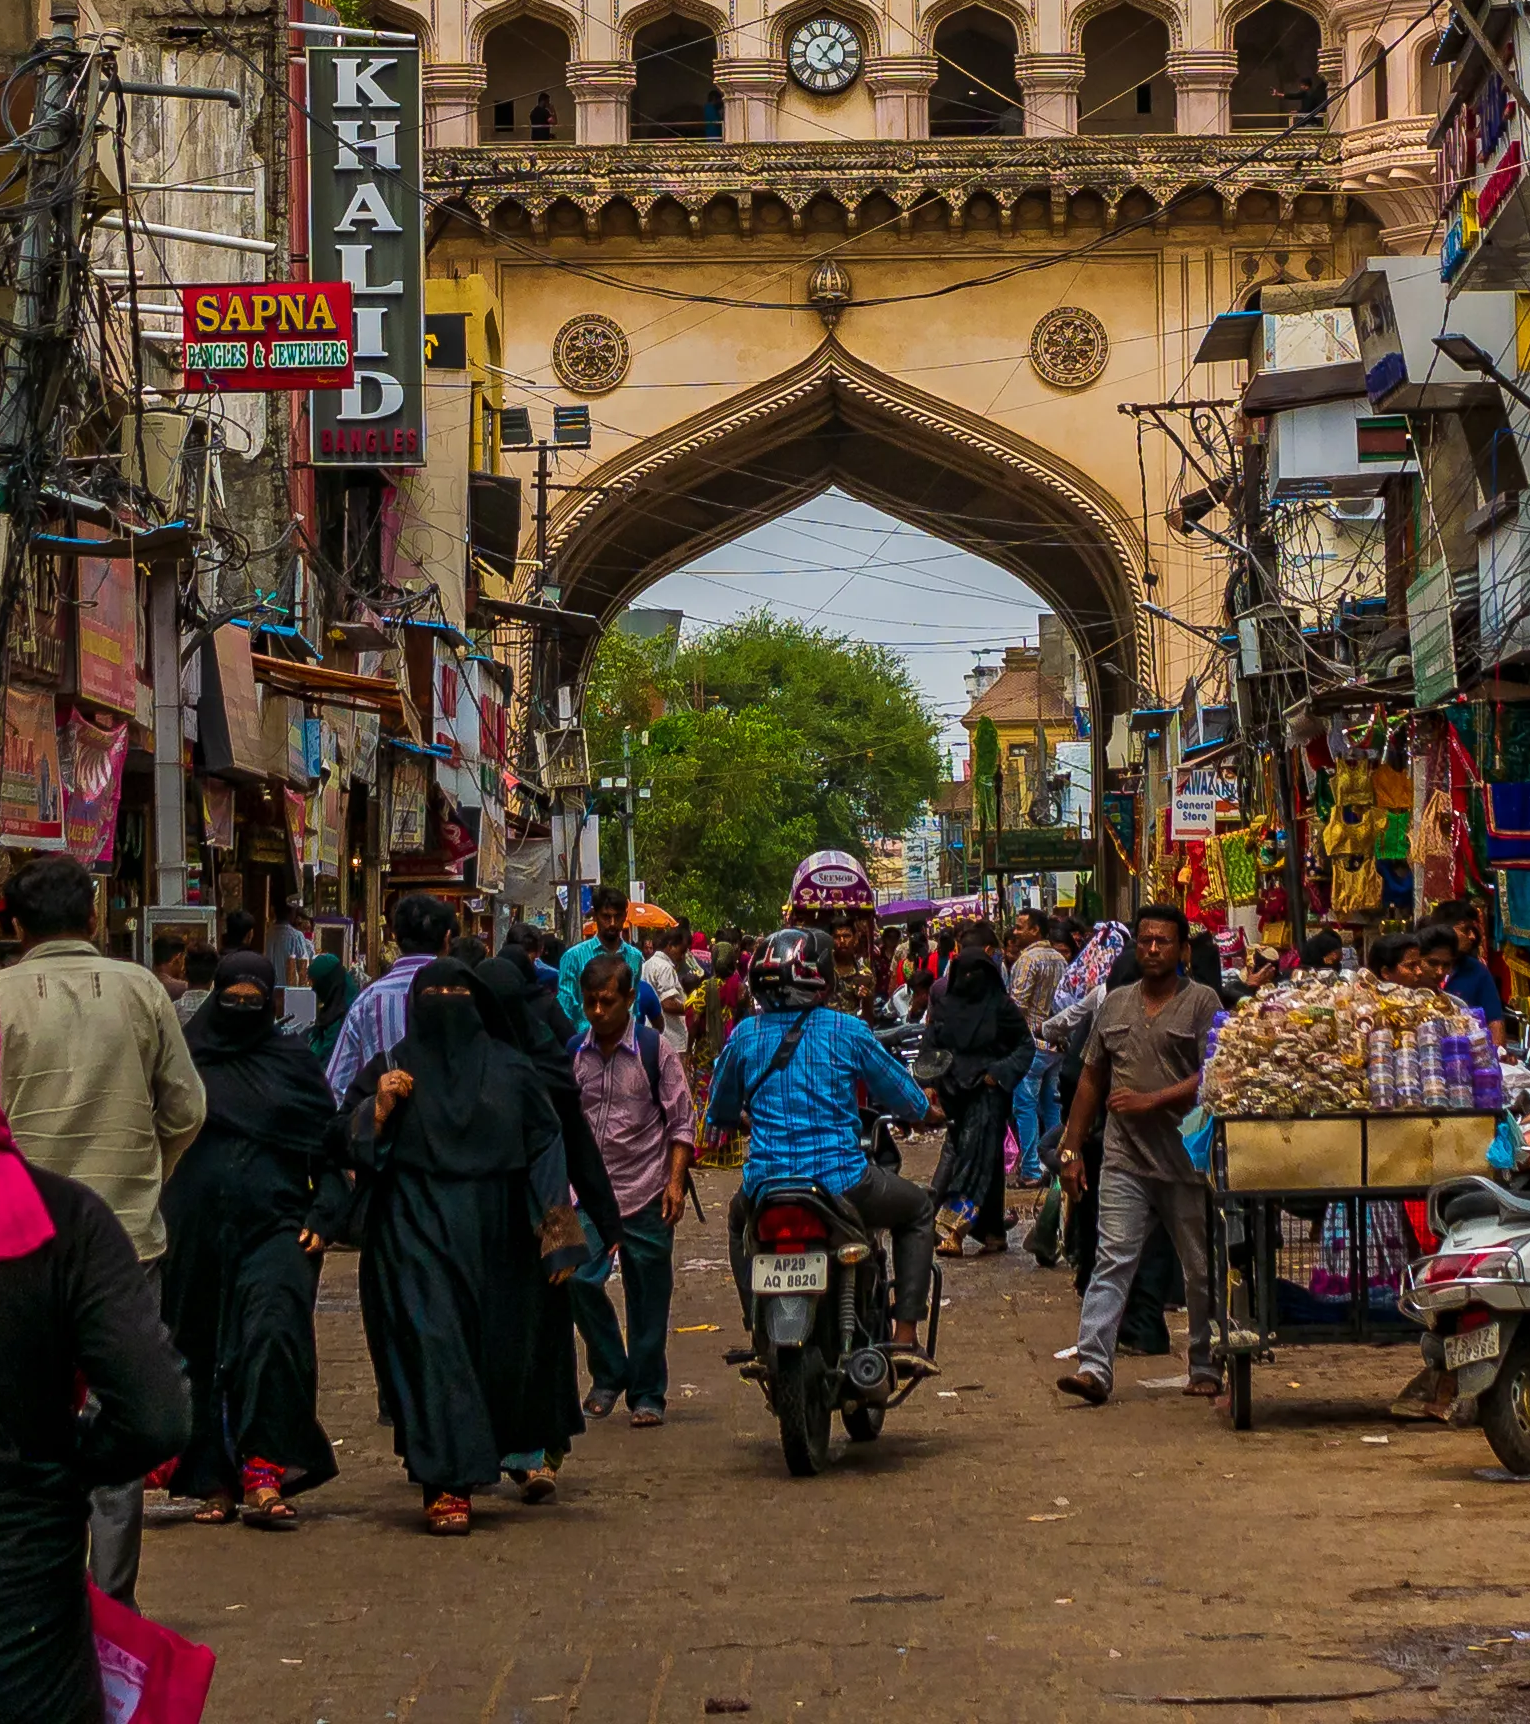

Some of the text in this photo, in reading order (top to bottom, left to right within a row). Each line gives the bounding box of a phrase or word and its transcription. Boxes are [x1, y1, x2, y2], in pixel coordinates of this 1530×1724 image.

[332, 57, 404, 421] KHALID
[196, 293, 338, 333] SAPNA
[186, 340, 349, 369] BANGLES & JEWELLERS
[320, 427, 419, 454] BANGLES
[1176, 799, 1213, 810] General
[1182, 811, 1207, 822] Store
